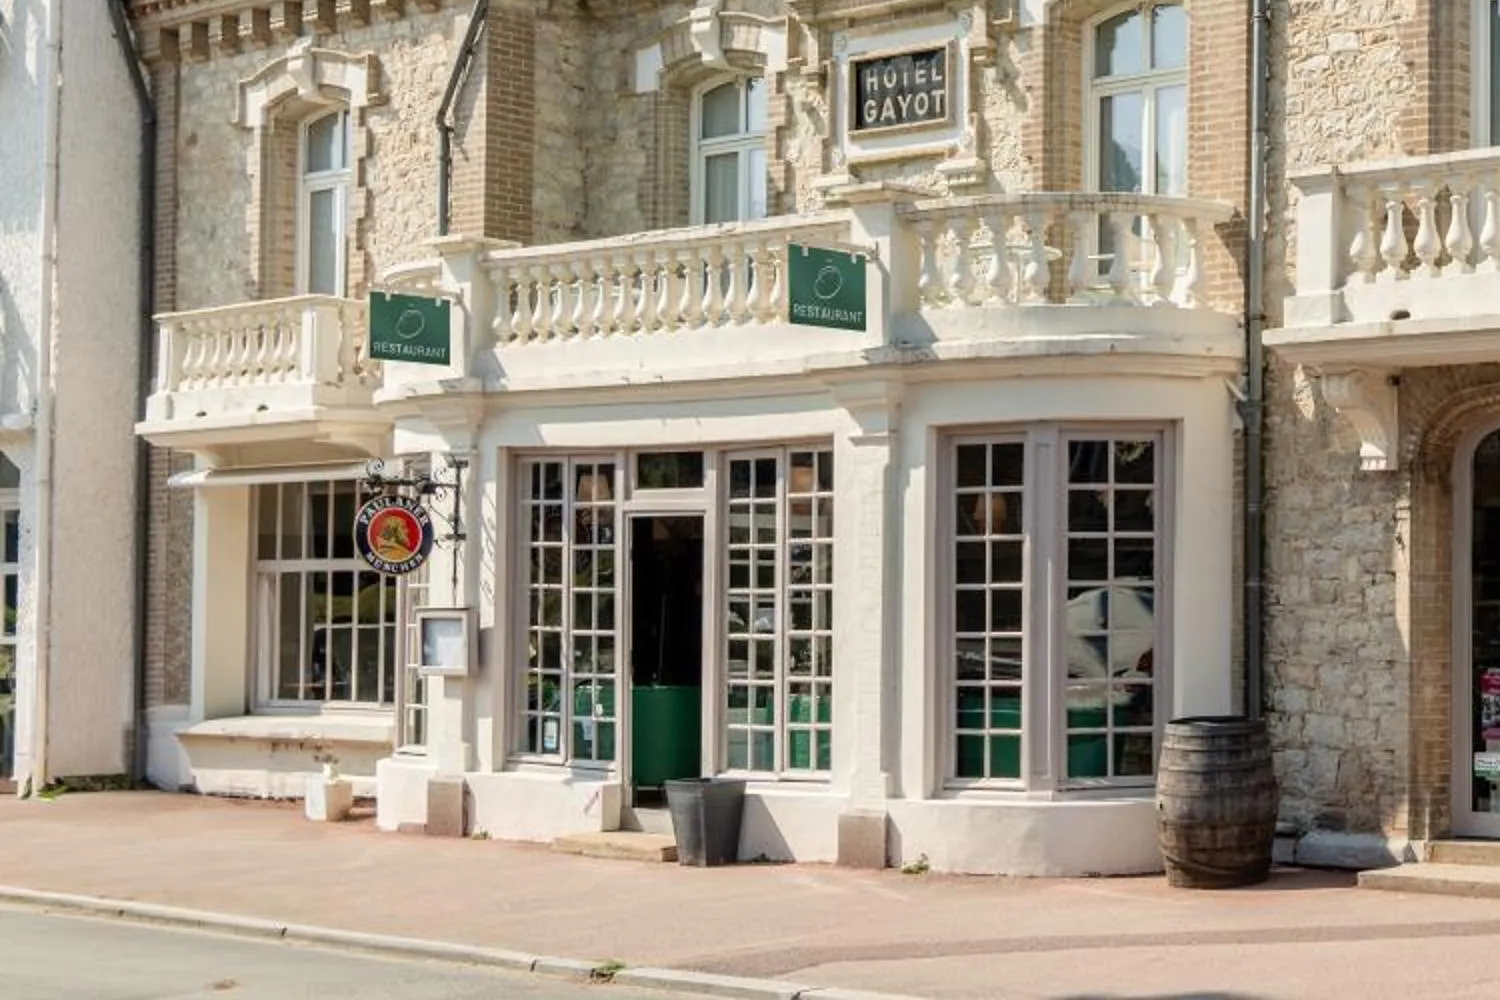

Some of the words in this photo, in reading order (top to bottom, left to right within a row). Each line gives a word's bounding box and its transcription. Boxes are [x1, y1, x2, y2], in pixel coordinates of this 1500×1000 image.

[864, 89, 944, 123] GAYOT
[793, 303, 864, 322] RESTAURANT
[373, 341, 446, 359] RESTAURANT
